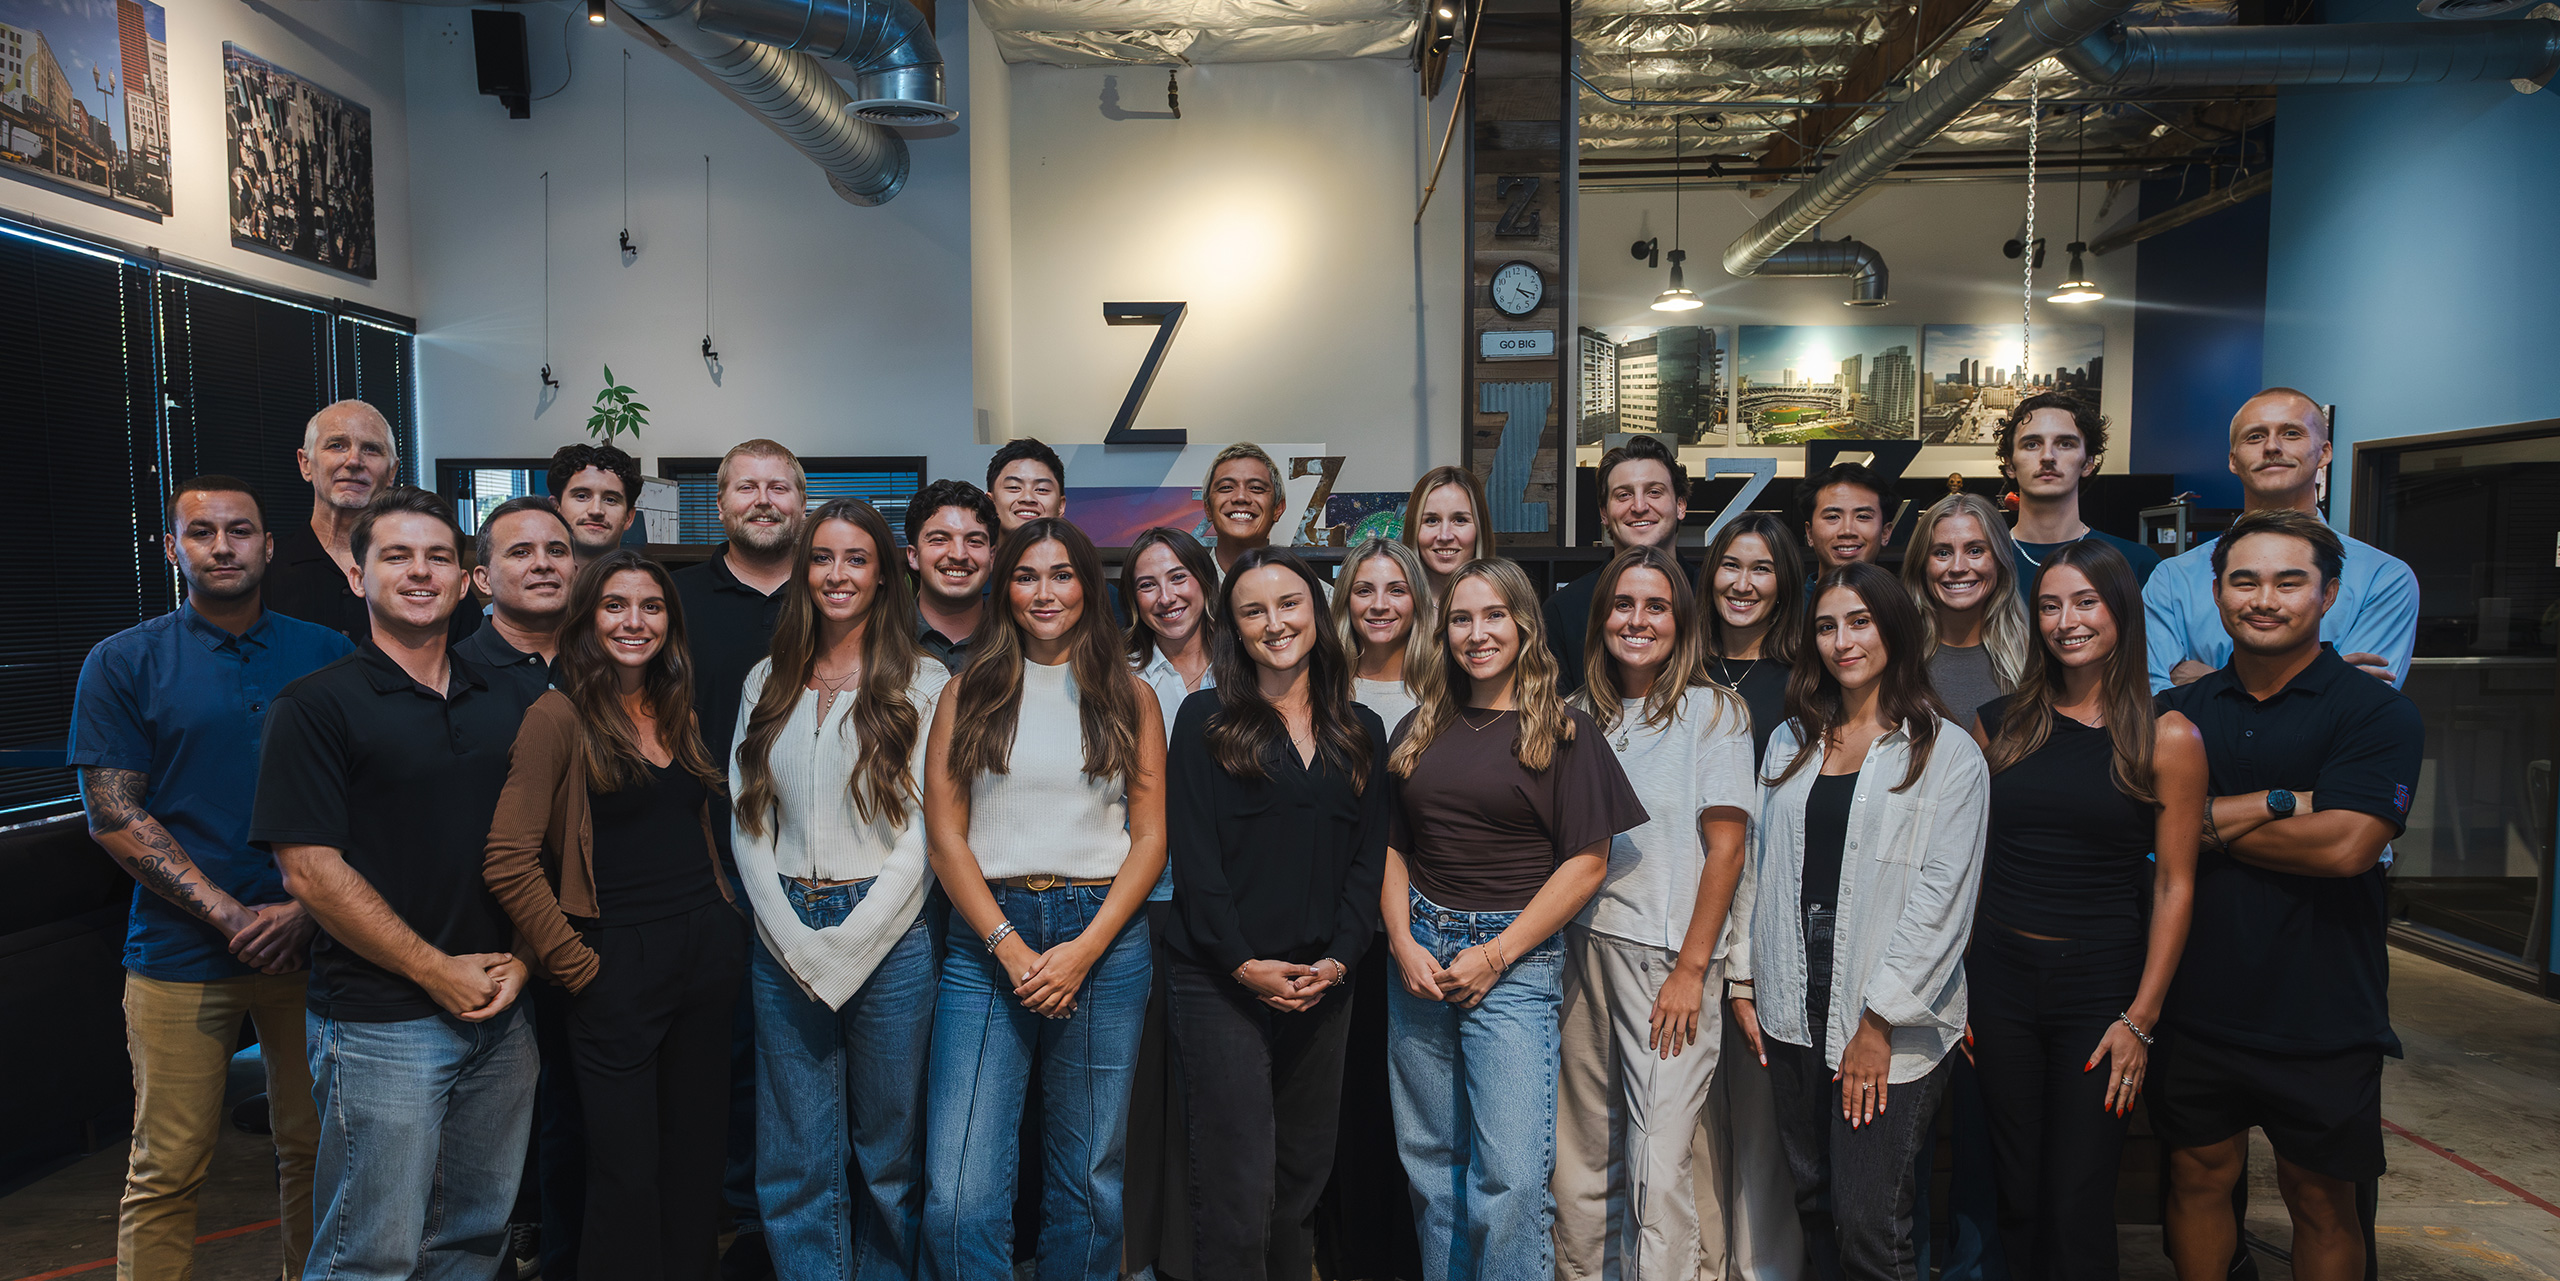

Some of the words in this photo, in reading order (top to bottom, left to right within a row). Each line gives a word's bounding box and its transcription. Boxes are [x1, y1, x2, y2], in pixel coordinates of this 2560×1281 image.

[1495, 176, 1541, 238] Z
[1513, 267, 1520, 275] 12
[1103, 302, 1188, 444] Z
[1500, 340, 1516, 349] GO
[1518, 339, 1536, 348] BIG
[1480, 382, 1552, 533] Z
[1289, 456, 1346, 547] Z
